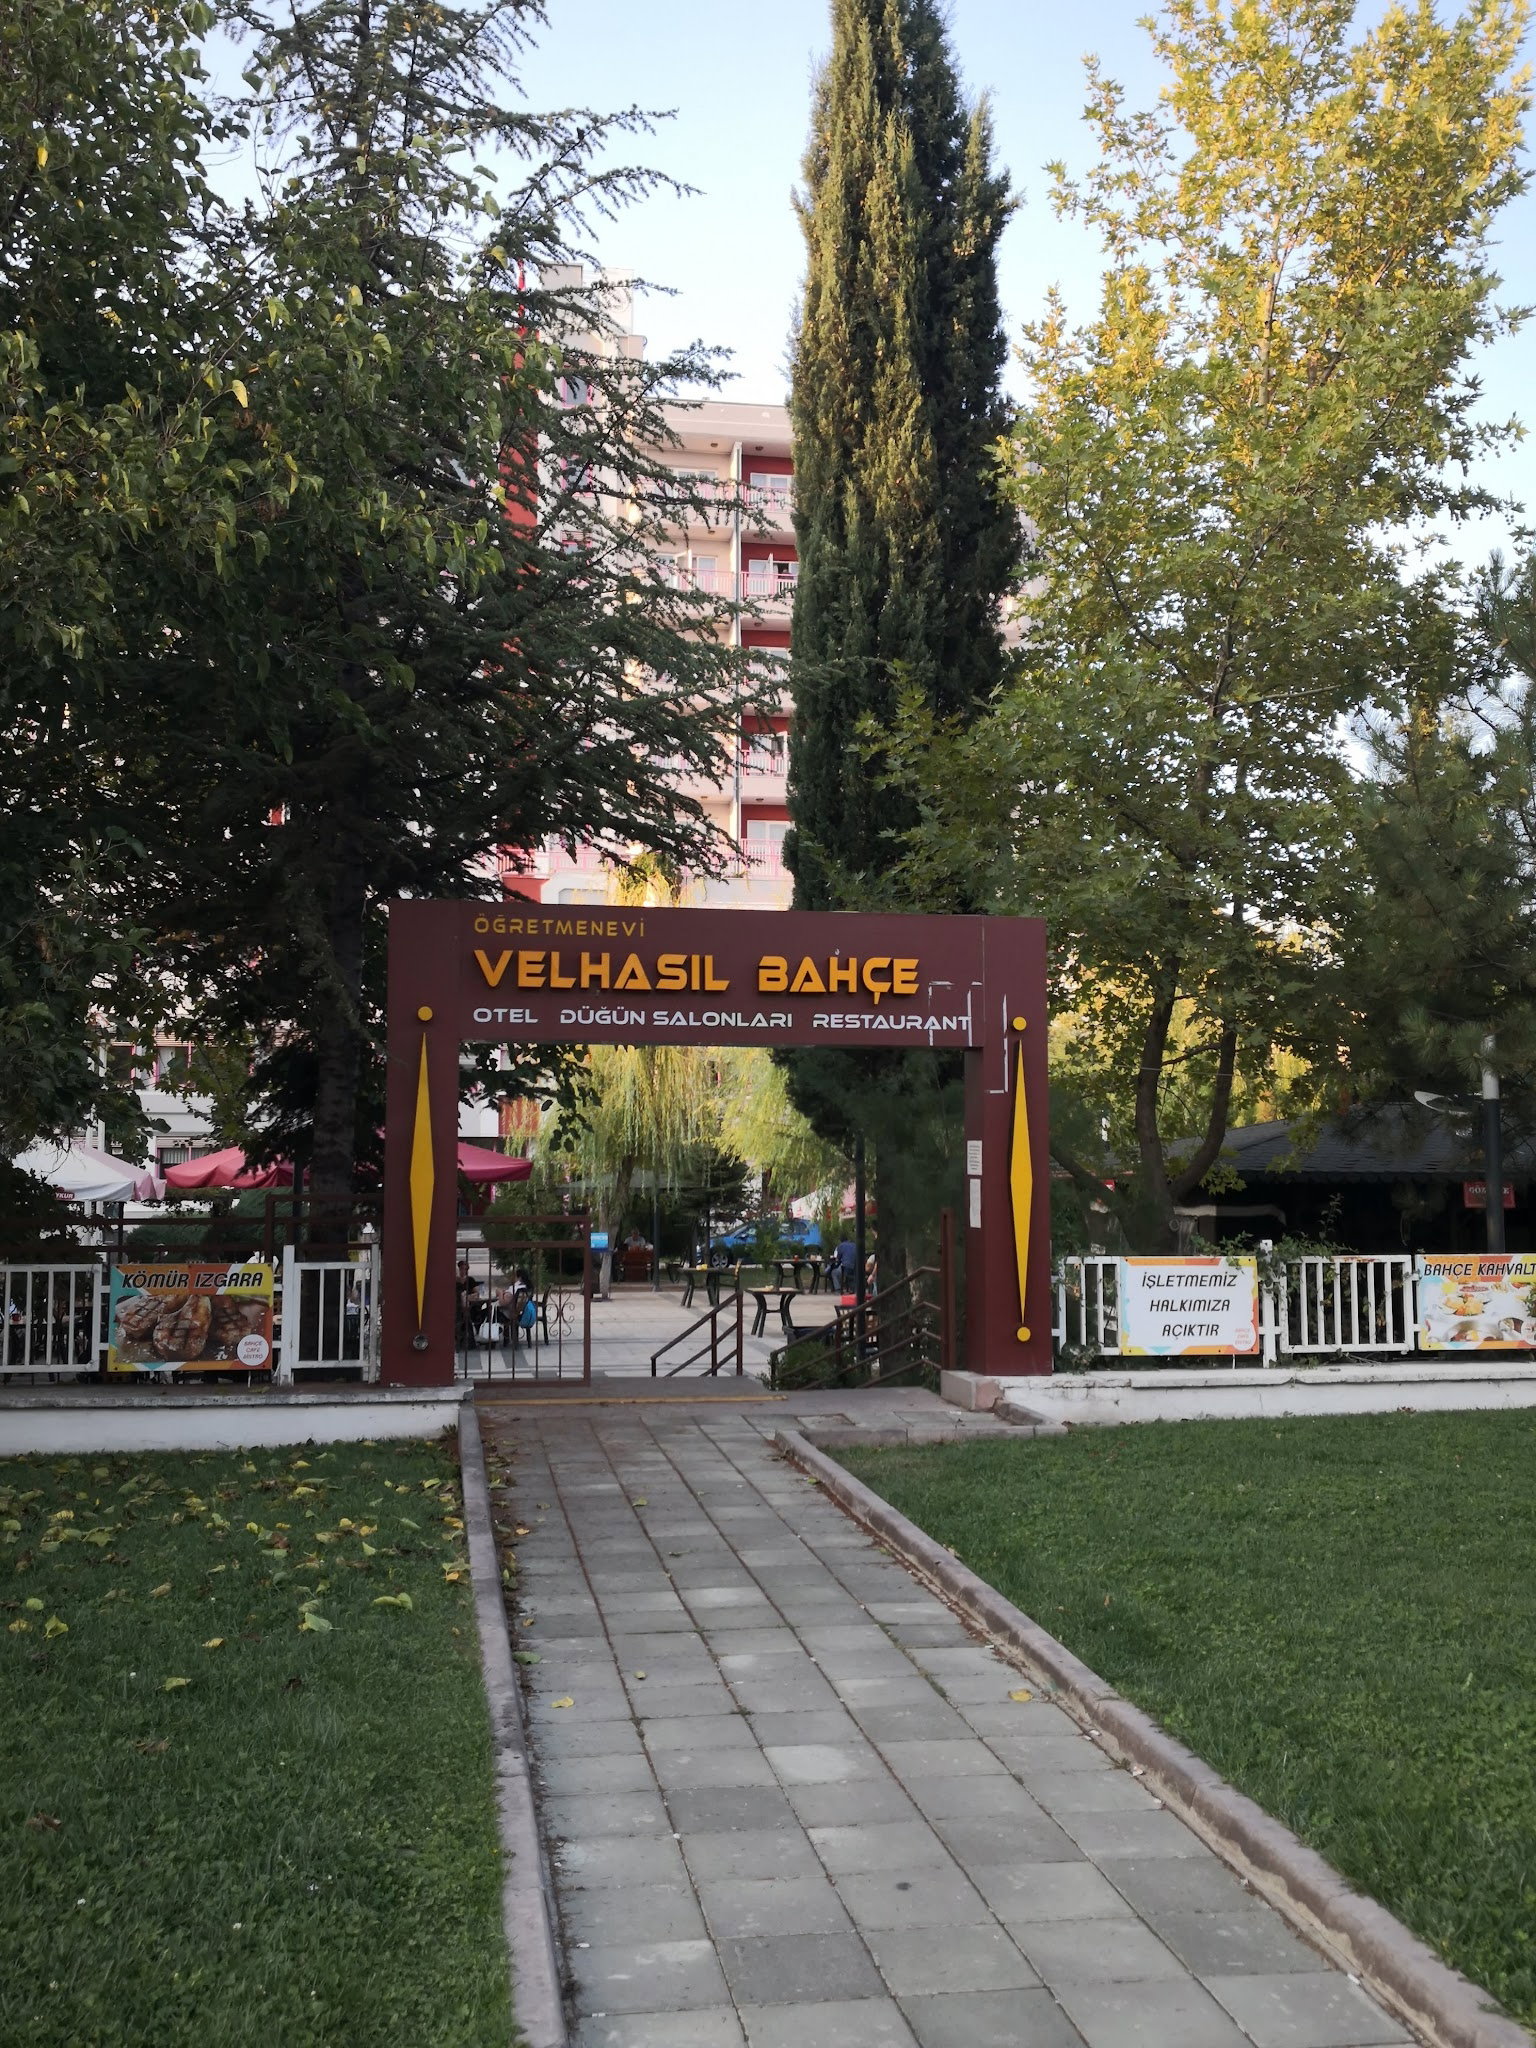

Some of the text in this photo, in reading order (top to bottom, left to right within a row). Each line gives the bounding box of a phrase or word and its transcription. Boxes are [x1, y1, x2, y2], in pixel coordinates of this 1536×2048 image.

[474, 912, 646, 937] ÖĞRETMENEVİ
[473, 949, 920, 1005] VELHASIL BAHÇE
[473, 1005, 972, 1031] OTEL DÜĞÜN SALONLARI RESTAURANT
[121, 1270, 264, 1289] KÖMÜR IZGARA
[1141, 1271, 1238, 1289] İŞLETMEMİZ
[1424, 1263, 1536, 1279] BAHÇE KAHVALT
[1149, 1299, 1230, 1312] HALKIMIZA
[1162, 1324, 1220, 1340] AÇIKTIR
